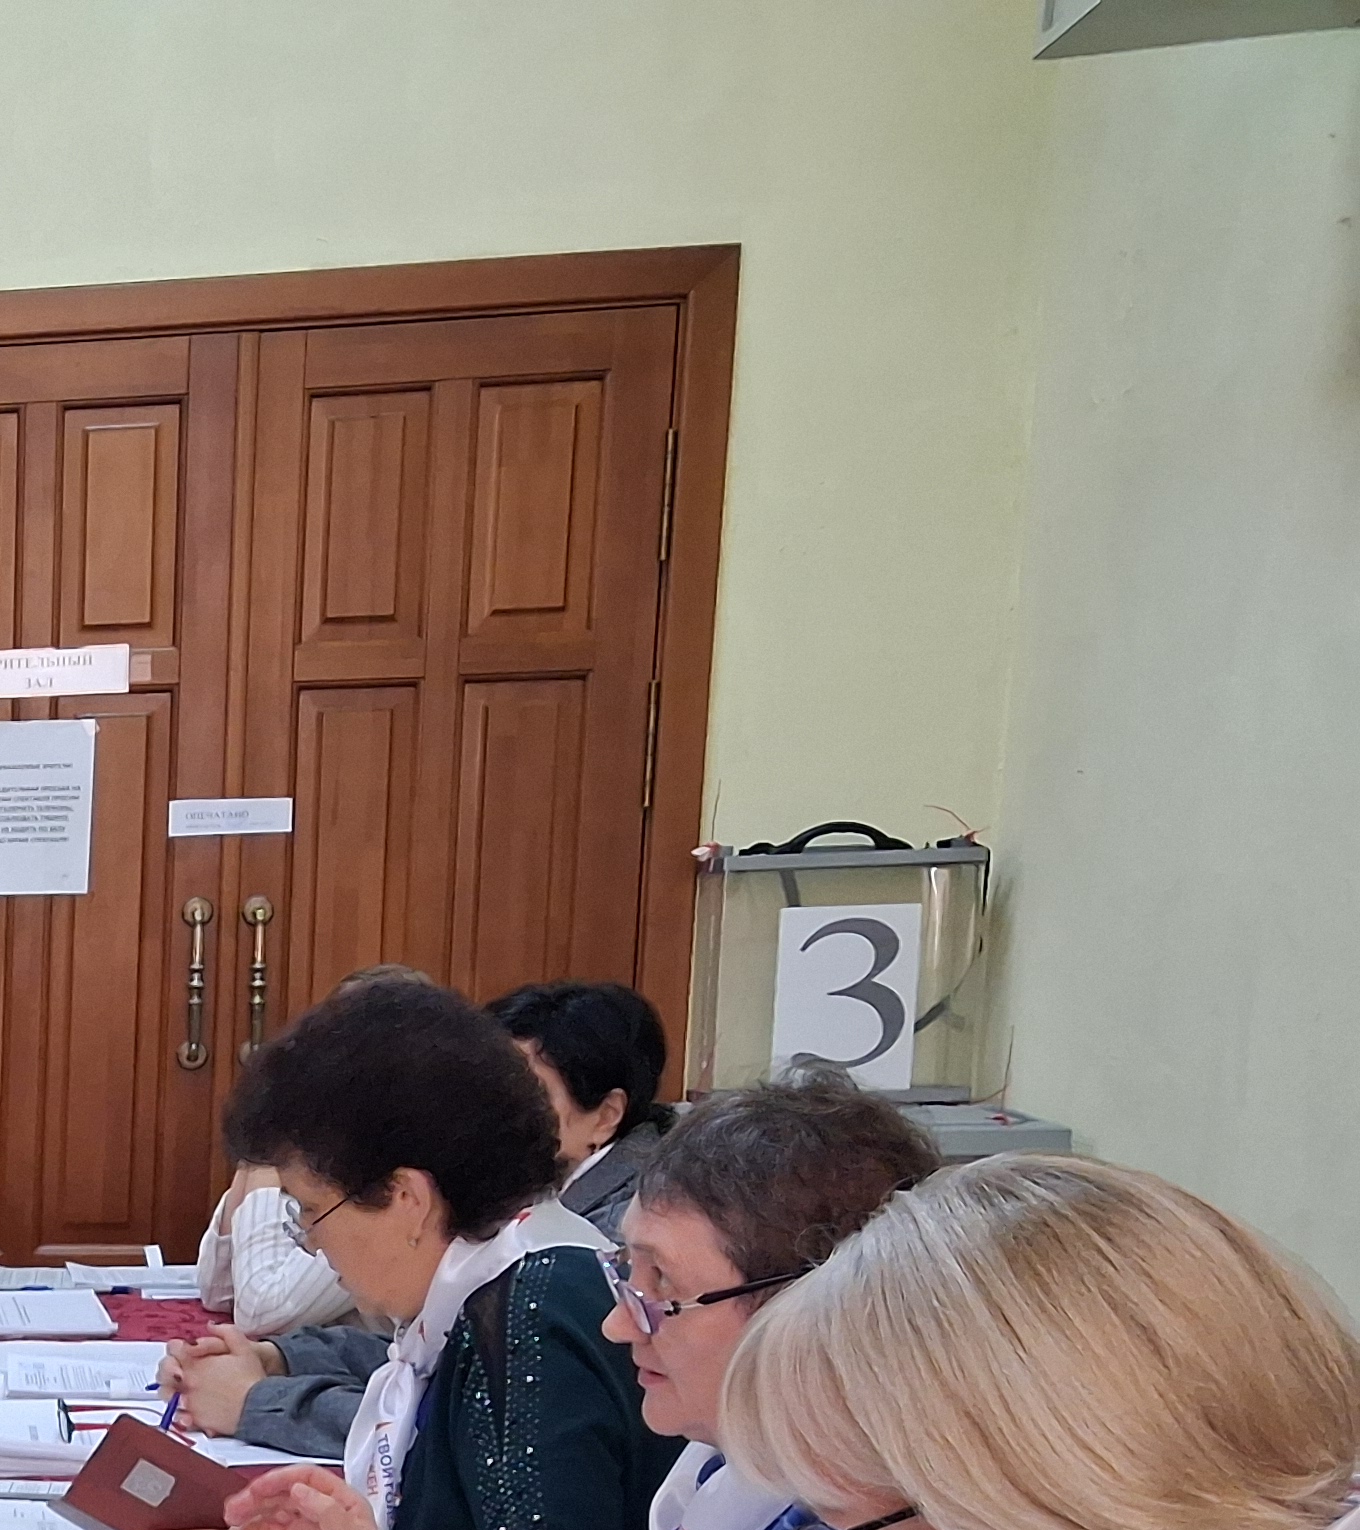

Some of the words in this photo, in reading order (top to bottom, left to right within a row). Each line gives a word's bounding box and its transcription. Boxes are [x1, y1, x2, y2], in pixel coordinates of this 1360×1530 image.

[25, 678, 53, 689] ЗАЛ
[185, 810, 249, 820] ОПЕЧАТАНО
[791, 917, 906, 1069] 3
